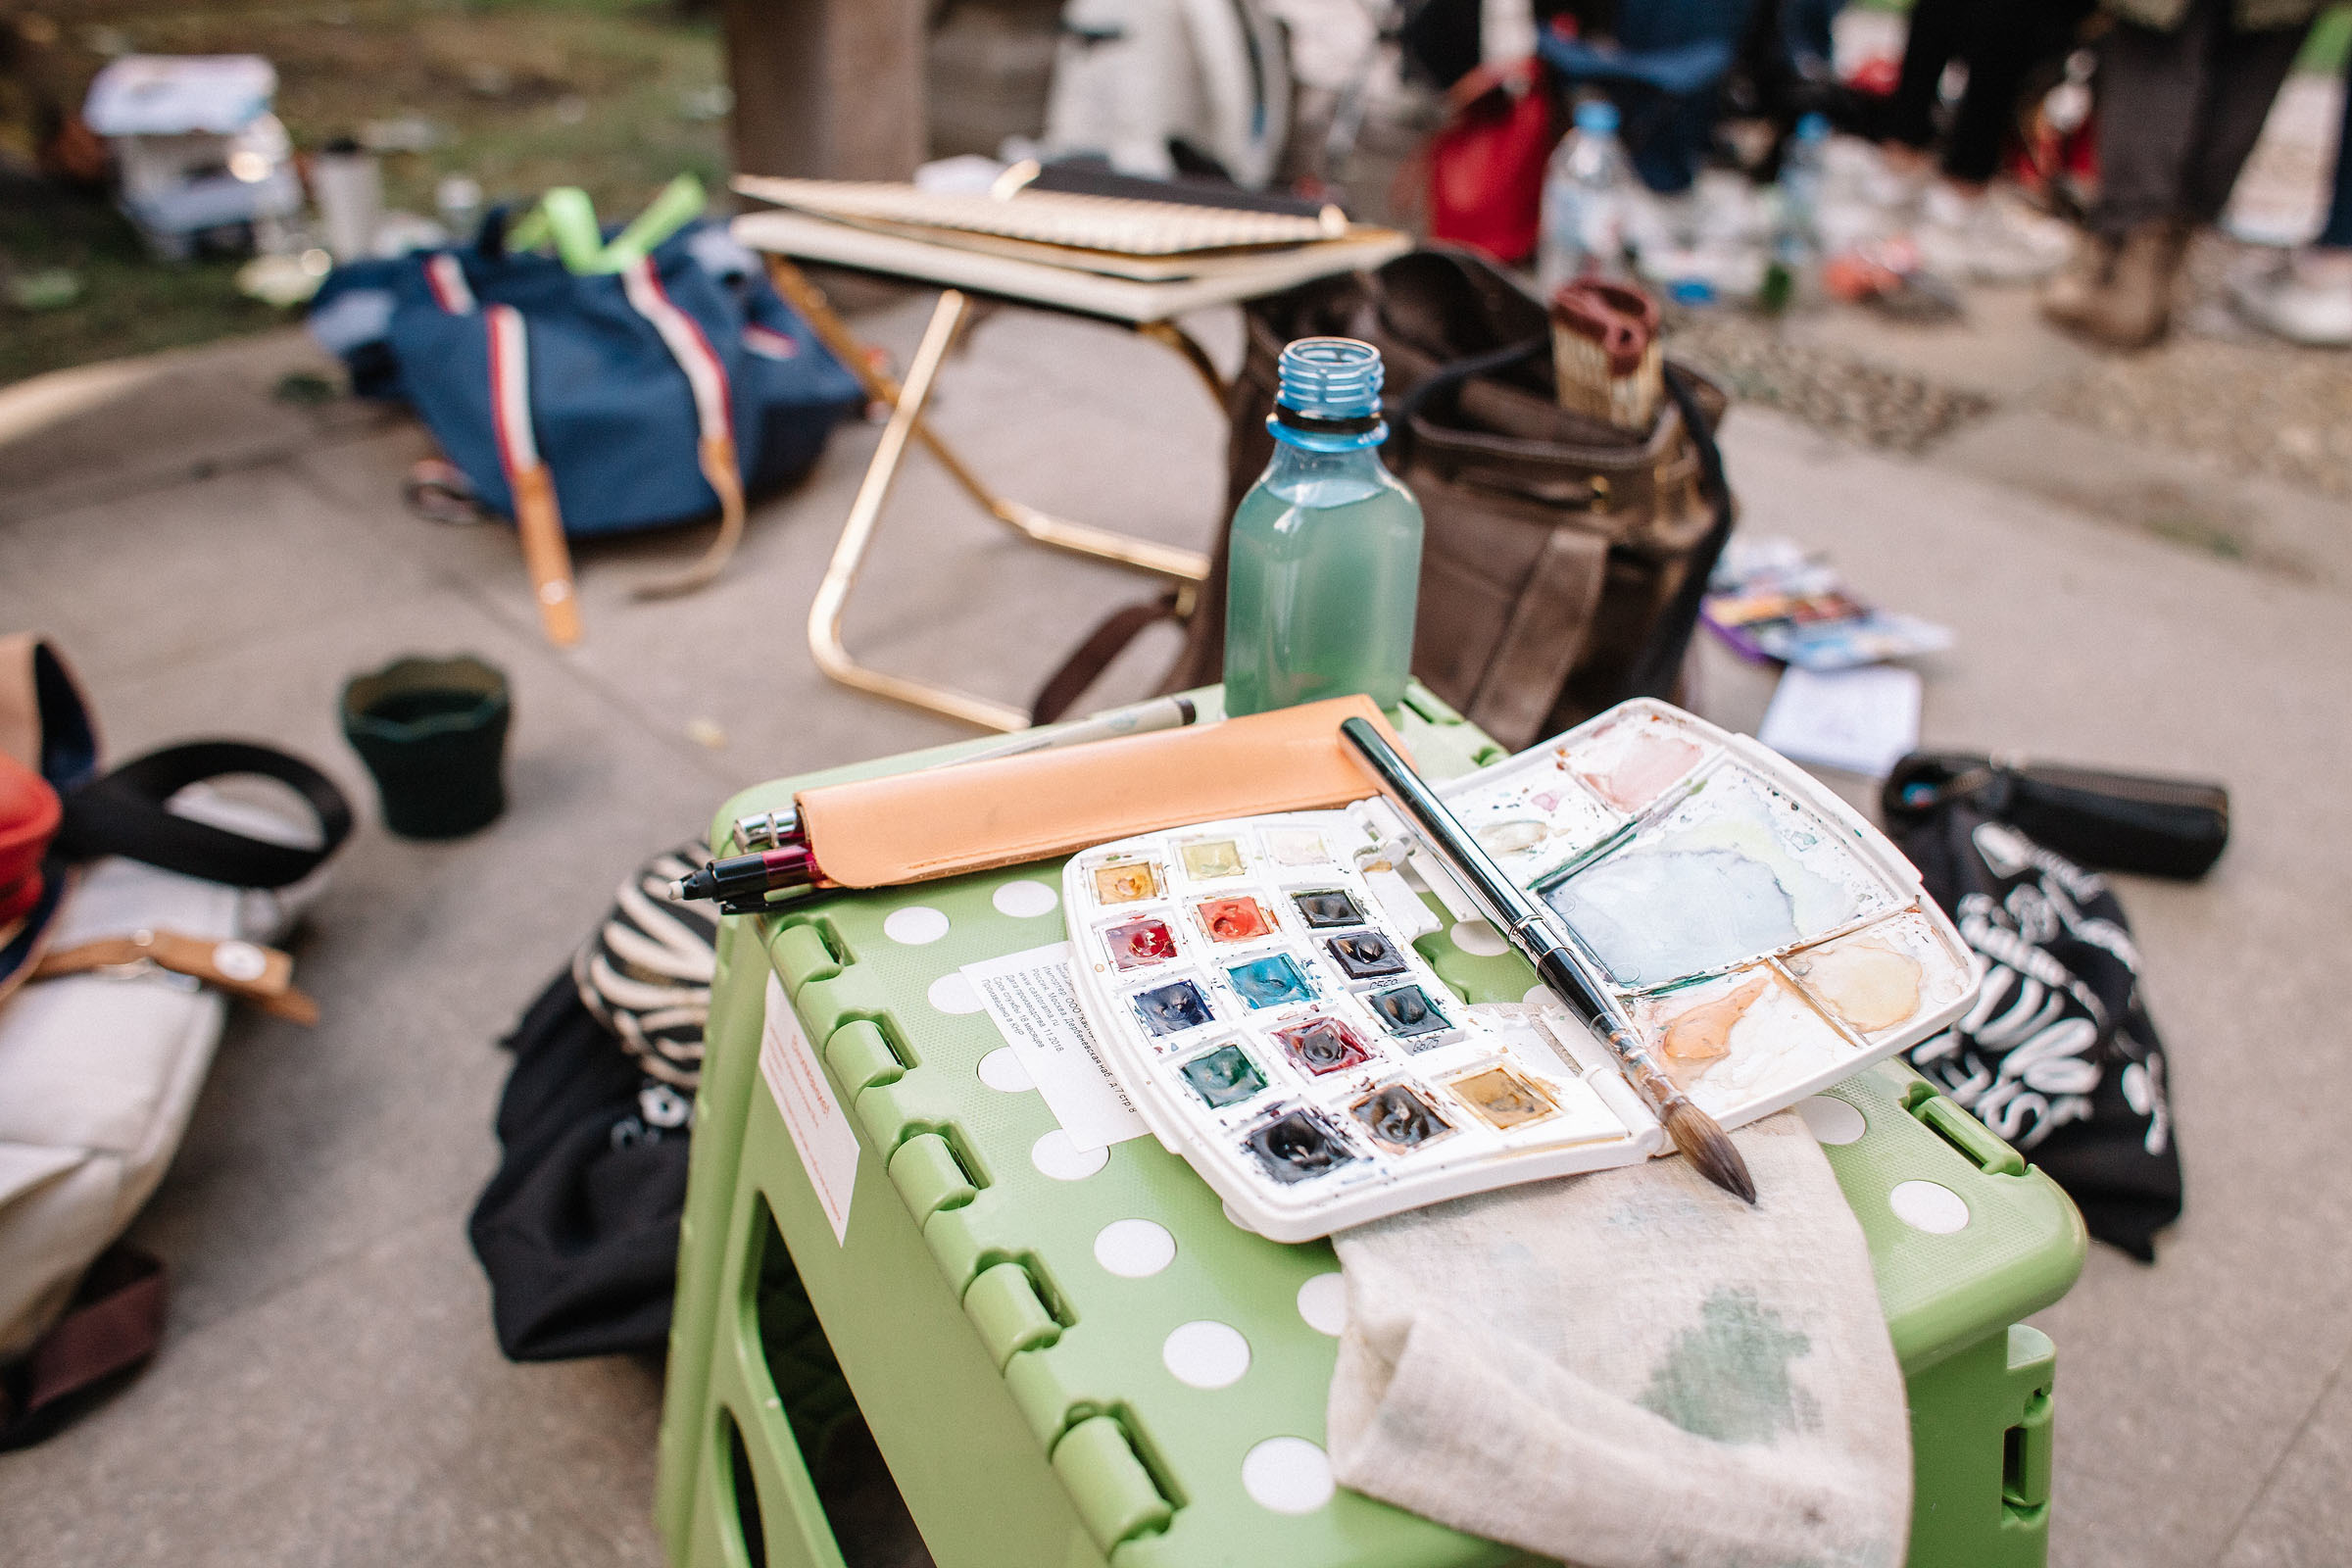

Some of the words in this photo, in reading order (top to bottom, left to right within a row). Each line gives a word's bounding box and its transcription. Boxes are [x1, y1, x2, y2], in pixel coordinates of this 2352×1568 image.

[981, 979, 1010, 1018] Произведено
[1009, 1021, 1025, 1036] КНР
[1004, 974, 1019, 989] Дата
[1018, 971, 1059, 1027] www.castorama.ru
[1065, 997, 1082, 1014] ООО
[993, 976, 1006, 992] Срок
[1023, 1022, 1045, 1049] месяцев
[1063, 1017, 1102, 1065] Дербеневская
